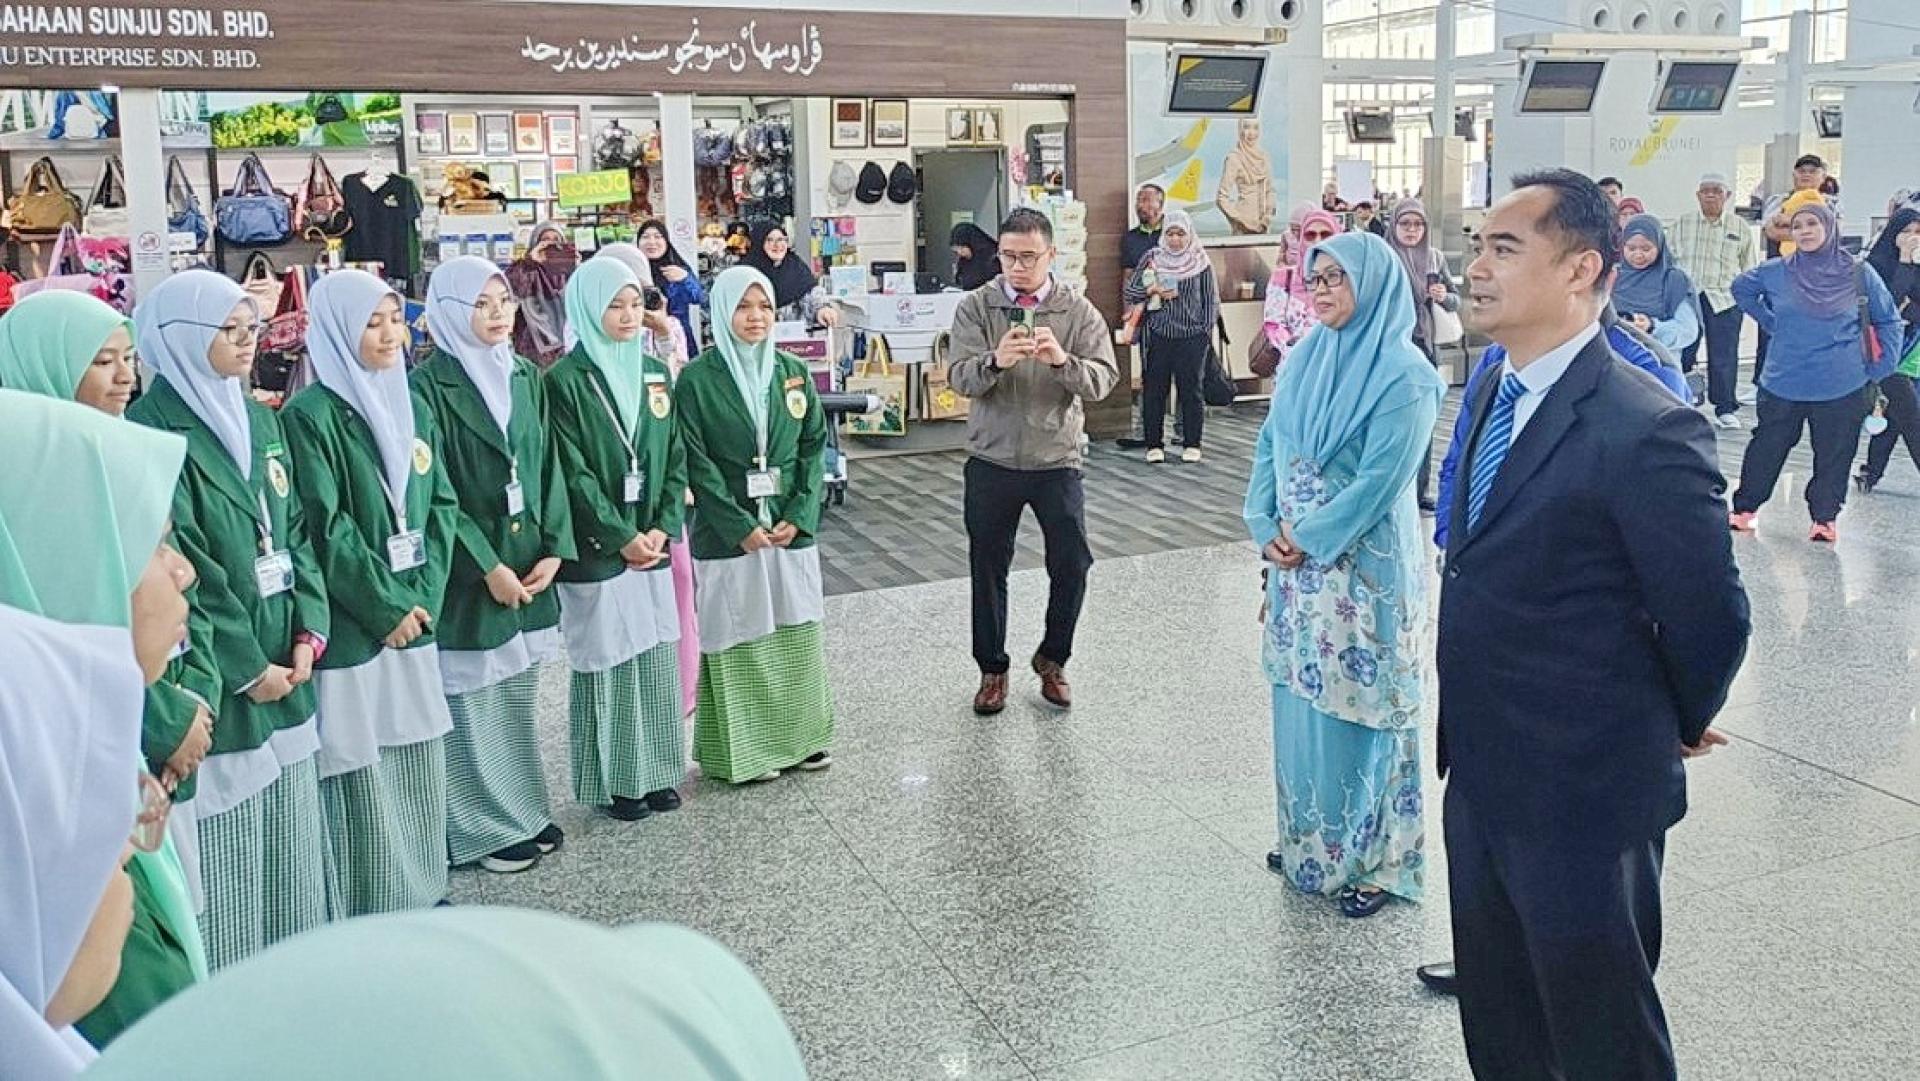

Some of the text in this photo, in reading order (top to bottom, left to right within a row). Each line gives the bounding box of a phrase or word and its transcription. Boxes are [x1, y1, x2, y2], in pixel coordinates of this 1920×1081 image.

[0, 4, 275, 38] AHAAN SUNJU SDN. BHD.
[23, 46, 158, 67] ENTERPRISE
[161, 48, 208, 67] SDN.
[212, 50, 261, 68] BHD.
[1609, 137, 1648, 153] ROYAL
